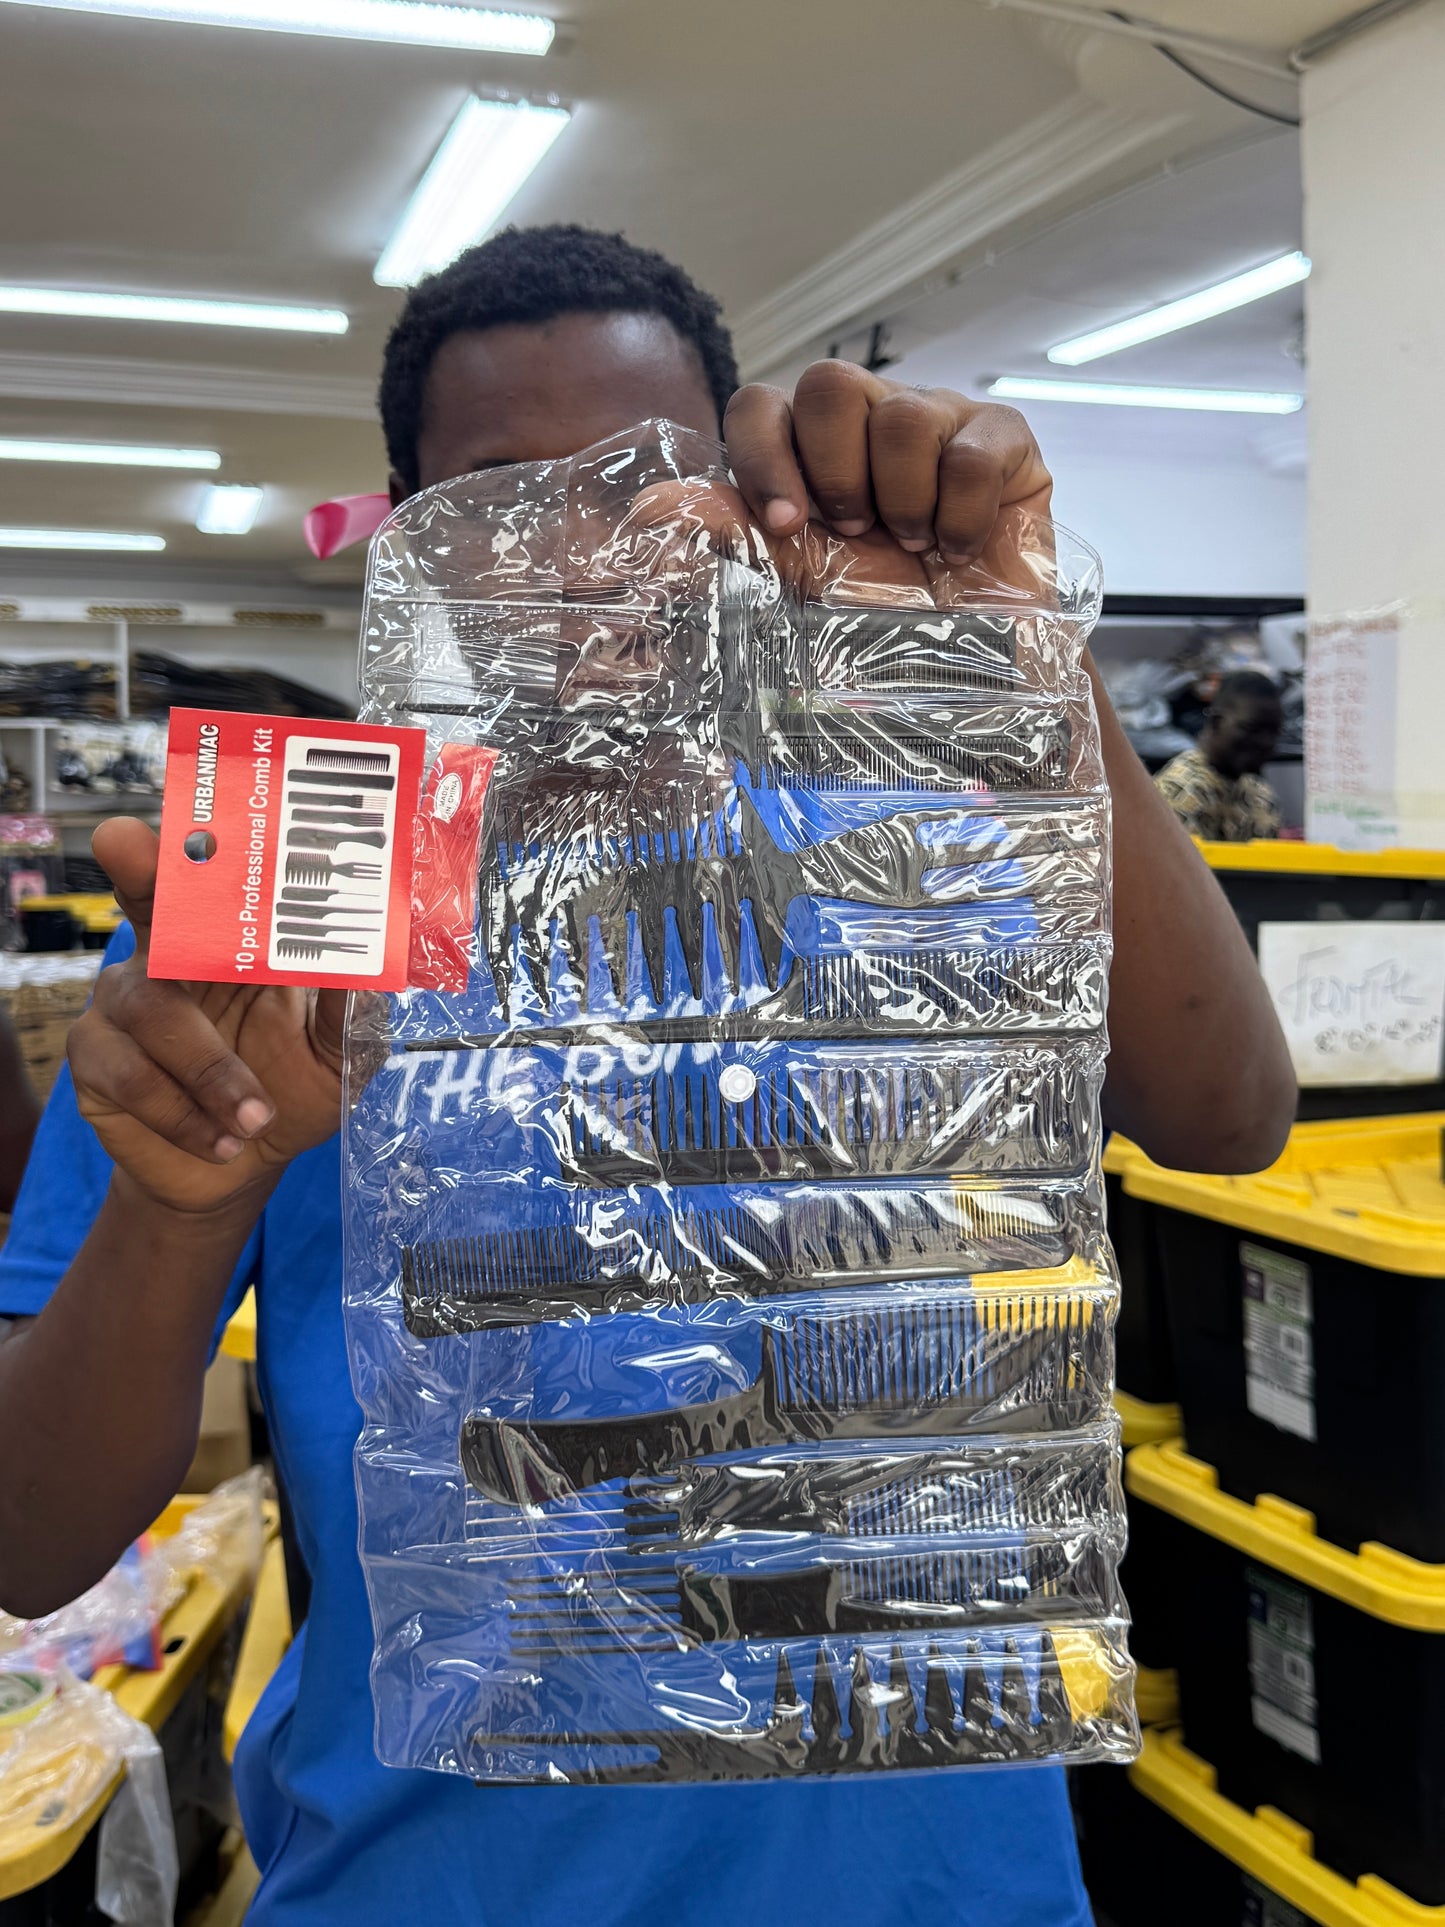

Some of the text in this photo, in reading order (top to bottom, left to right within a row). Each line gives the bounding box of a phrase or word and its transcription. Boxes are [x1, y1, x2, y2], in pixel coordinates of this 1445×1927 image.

[192, 723, 220, 823] URBANMAC
[439, 785, 450, 807] MADE
[447, 780, 458, 803] CHINA
[235, 728, 273, 972] 10 pc Professional Comb Kit
[384, 1046, 540, 1124] THE
